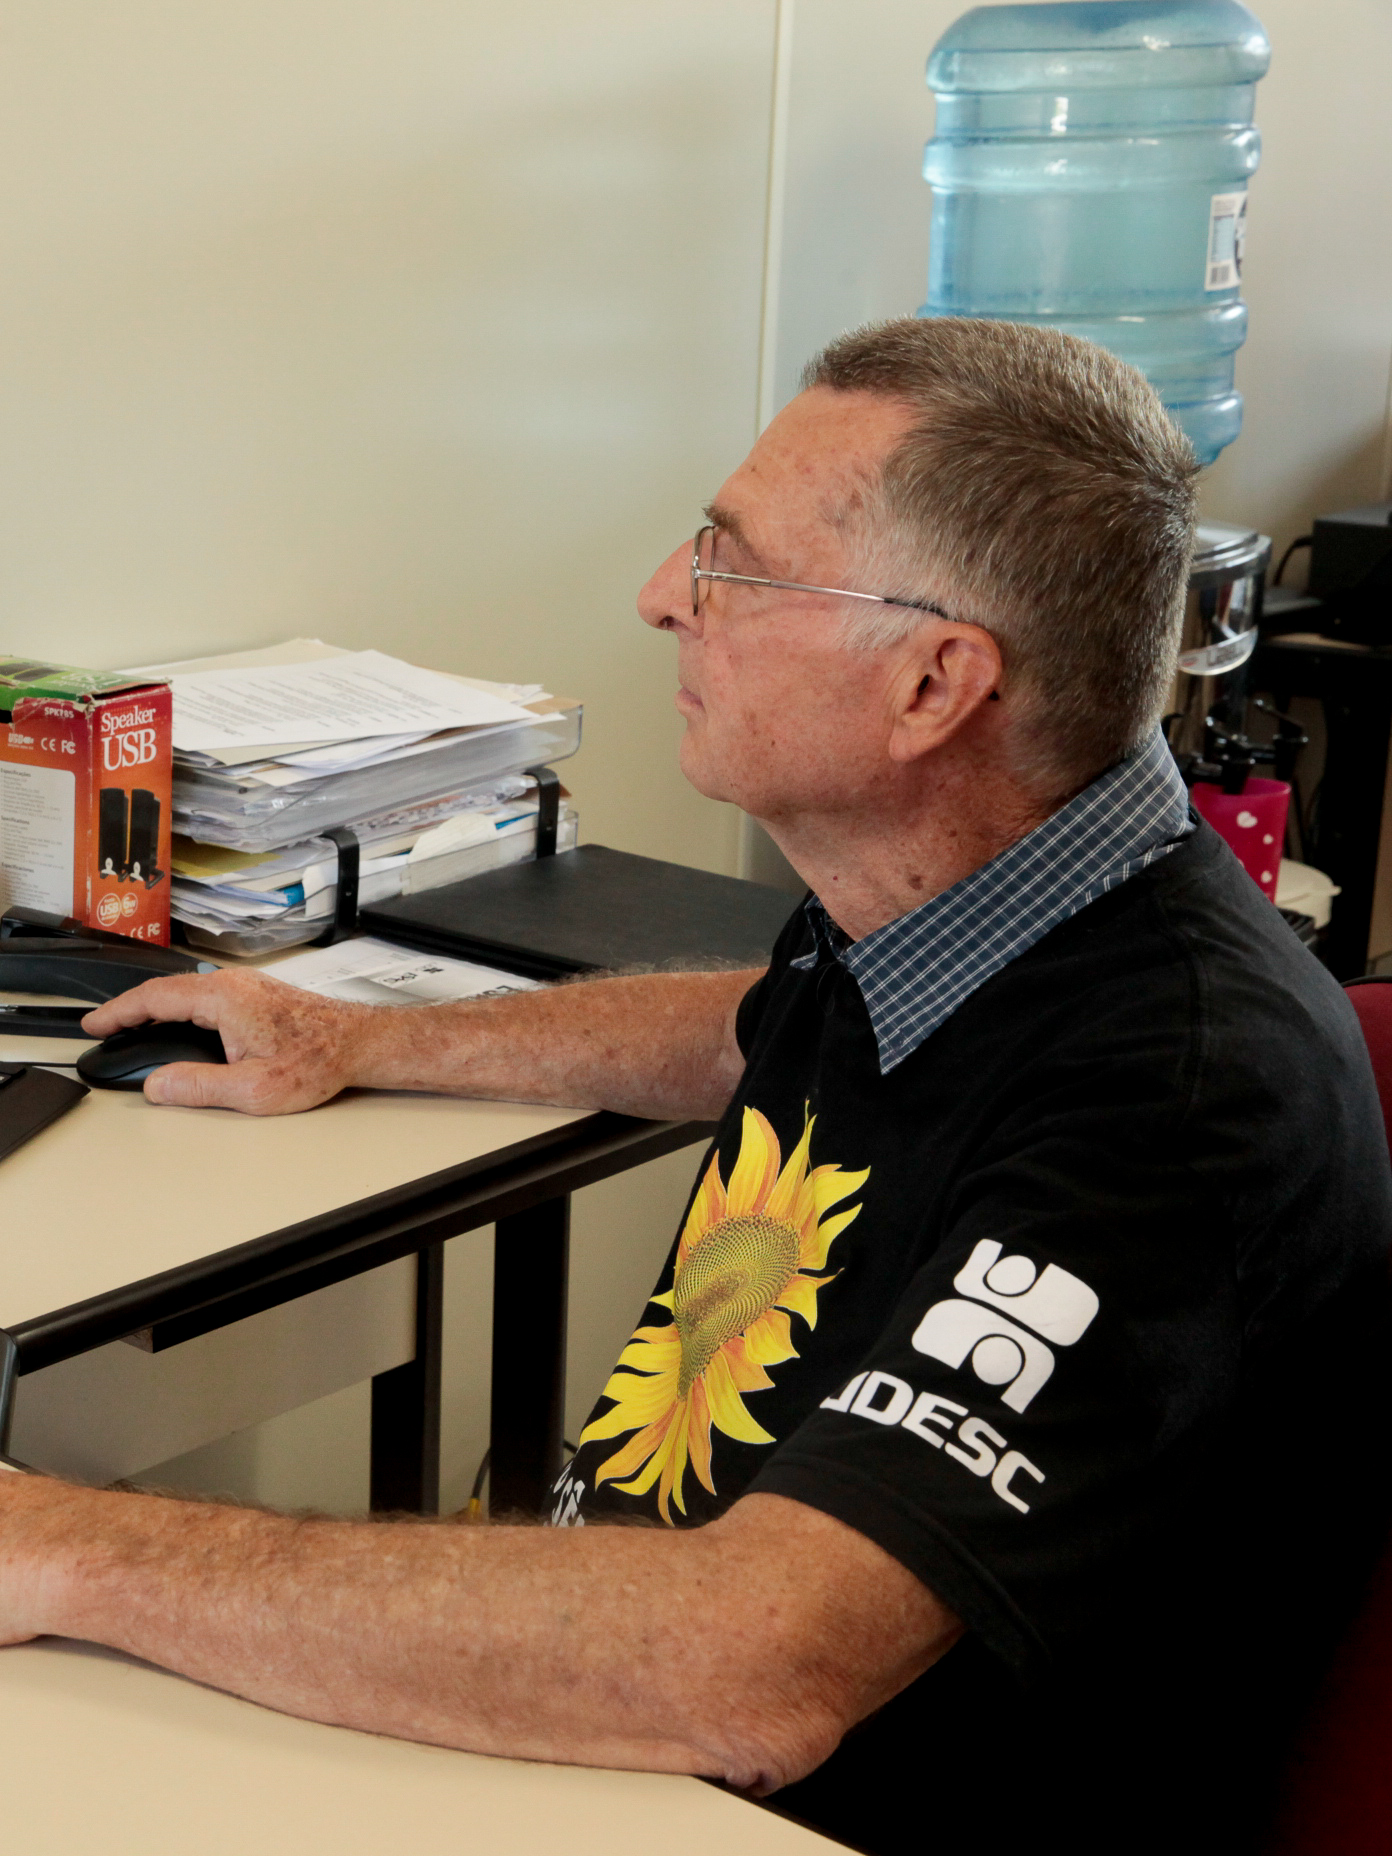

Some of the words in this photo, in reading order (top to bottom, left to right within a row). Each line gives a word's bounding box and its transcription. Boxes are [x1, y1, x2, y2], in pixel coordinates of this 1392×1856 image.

[101, 705, 156, 733] Speaker
[40, 737, 56, 752] CE
[102, 728, 157, 771] USB
[100, 902, 118, 916] USB
